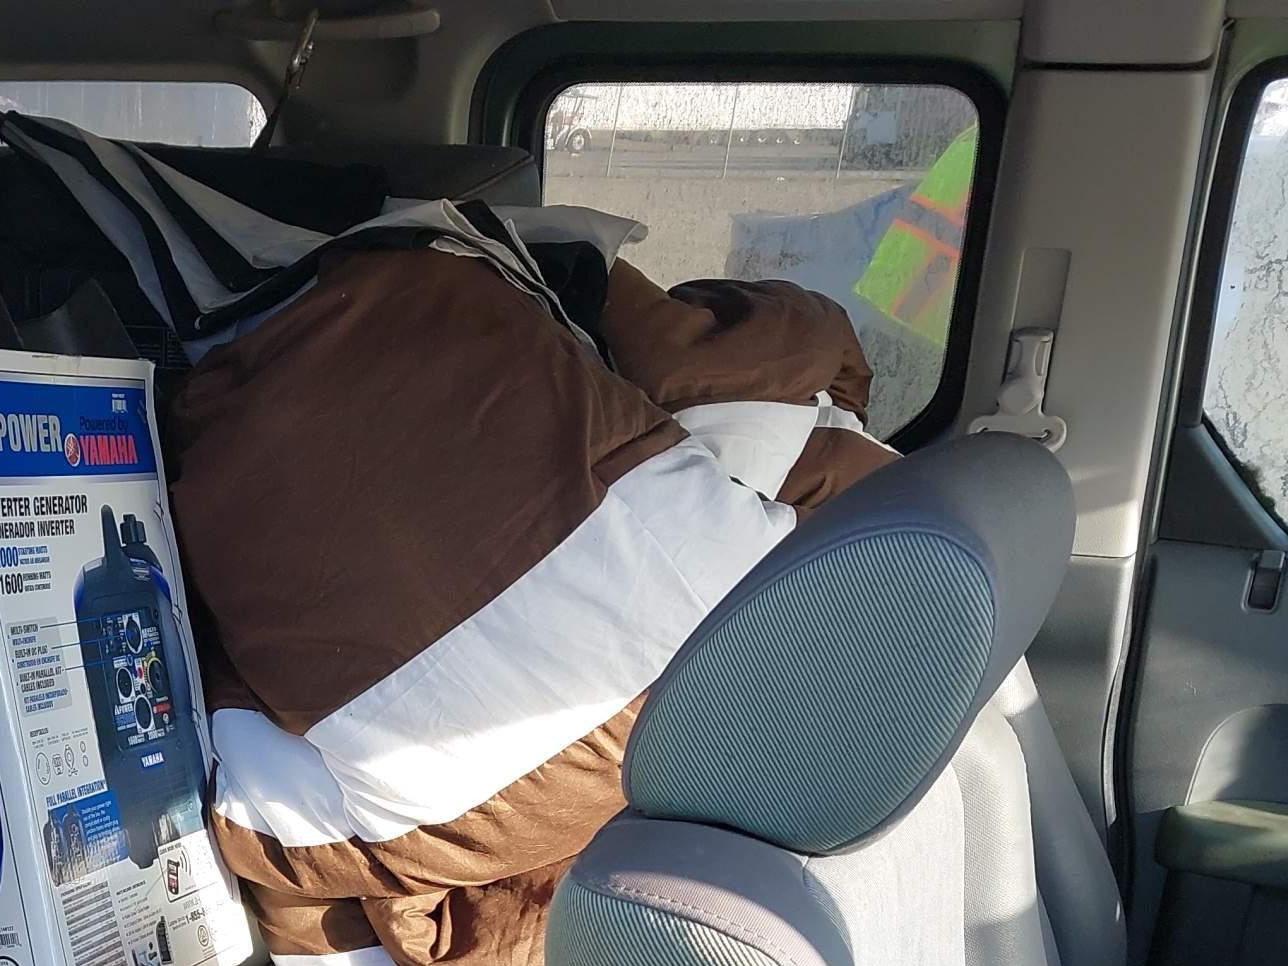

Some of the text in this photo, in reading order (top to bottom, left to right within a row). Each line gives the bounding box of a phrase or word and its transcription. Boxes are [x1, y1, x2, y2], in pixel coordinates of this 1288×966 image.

[79, 435, 139, 466] YAMAHA
[33, 495, 88, 516] GENERATOR
[37, 519, 75, 537] INVERTER
[0, 573, 24, 595] 1600
[141, 752, 164, 768] YAMAHA
[46, 796, 56, 807] FULL
[56, 788, 77, 804] PARALLEL
